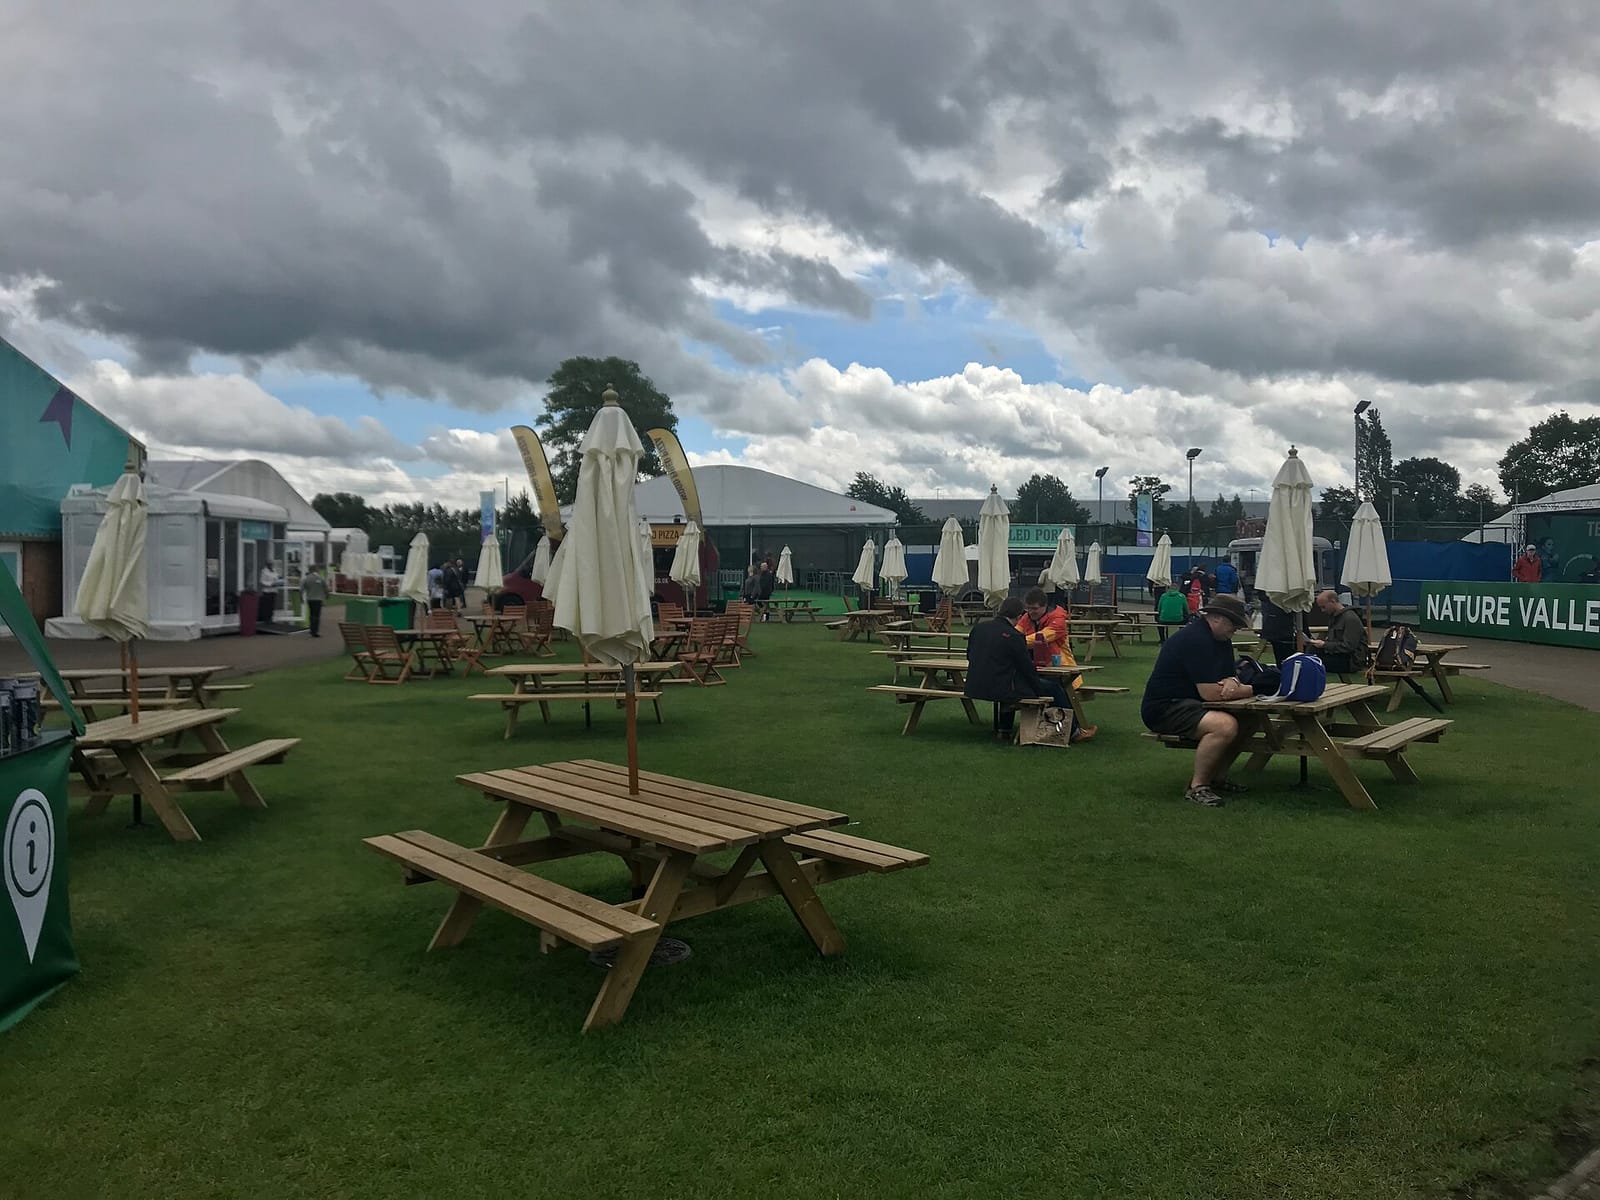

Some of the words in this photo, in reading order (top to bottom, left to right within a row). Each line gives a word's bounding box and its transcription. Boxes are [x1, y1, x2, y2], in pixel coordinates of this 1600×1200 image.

[658, 530, 679, 539] PIZZA
[1035, 529, 1062, 540] POR
[1426, 594, 1511, 626] NATURE
[1519, 597, 1600, 633] VALLE
